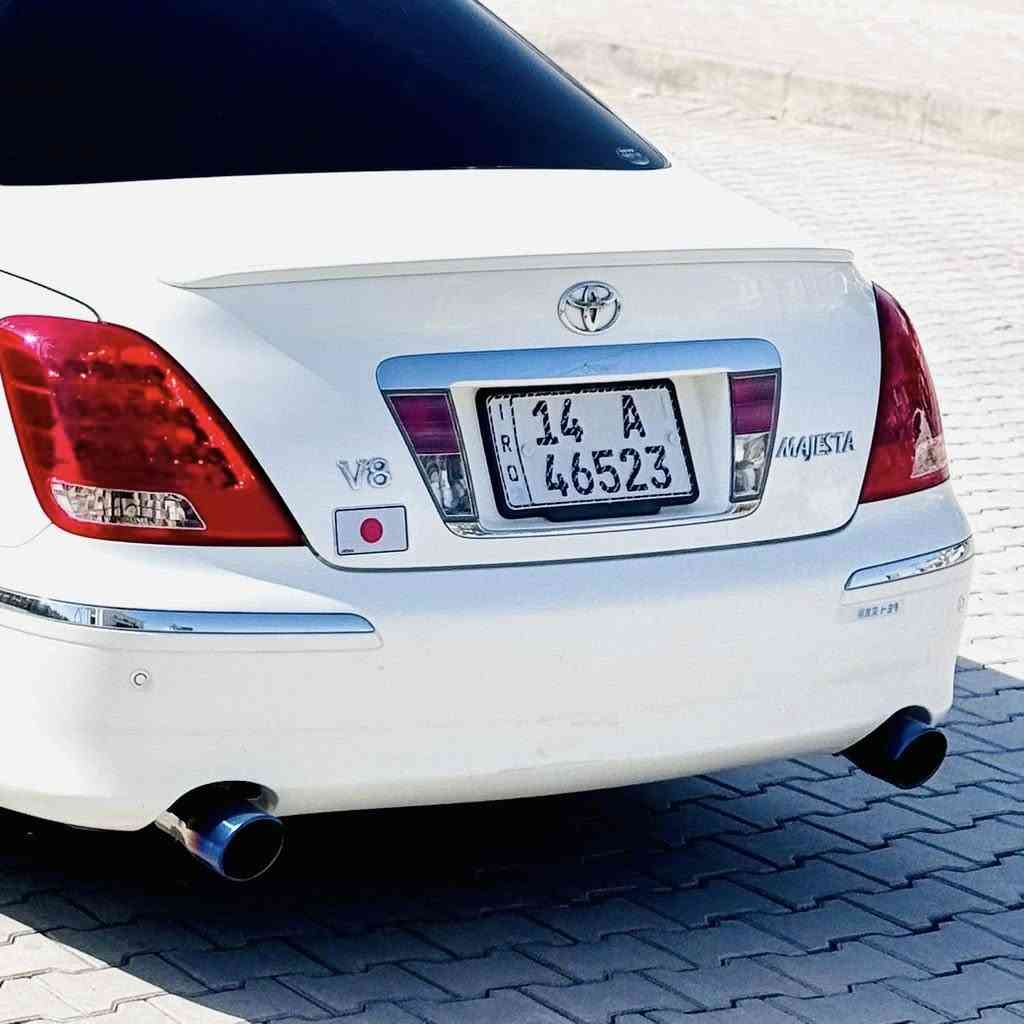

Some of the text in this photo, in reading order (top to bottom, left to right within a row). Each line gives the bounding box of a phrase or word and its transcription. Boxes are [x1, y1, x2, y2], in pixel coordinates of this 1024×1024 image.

[532, 394, 646, 446] 14 A
[775, 430, 855, 462] MAJESTA
[336, 456, 392, 491] V8
[545, 444, 672, 497] 46523
